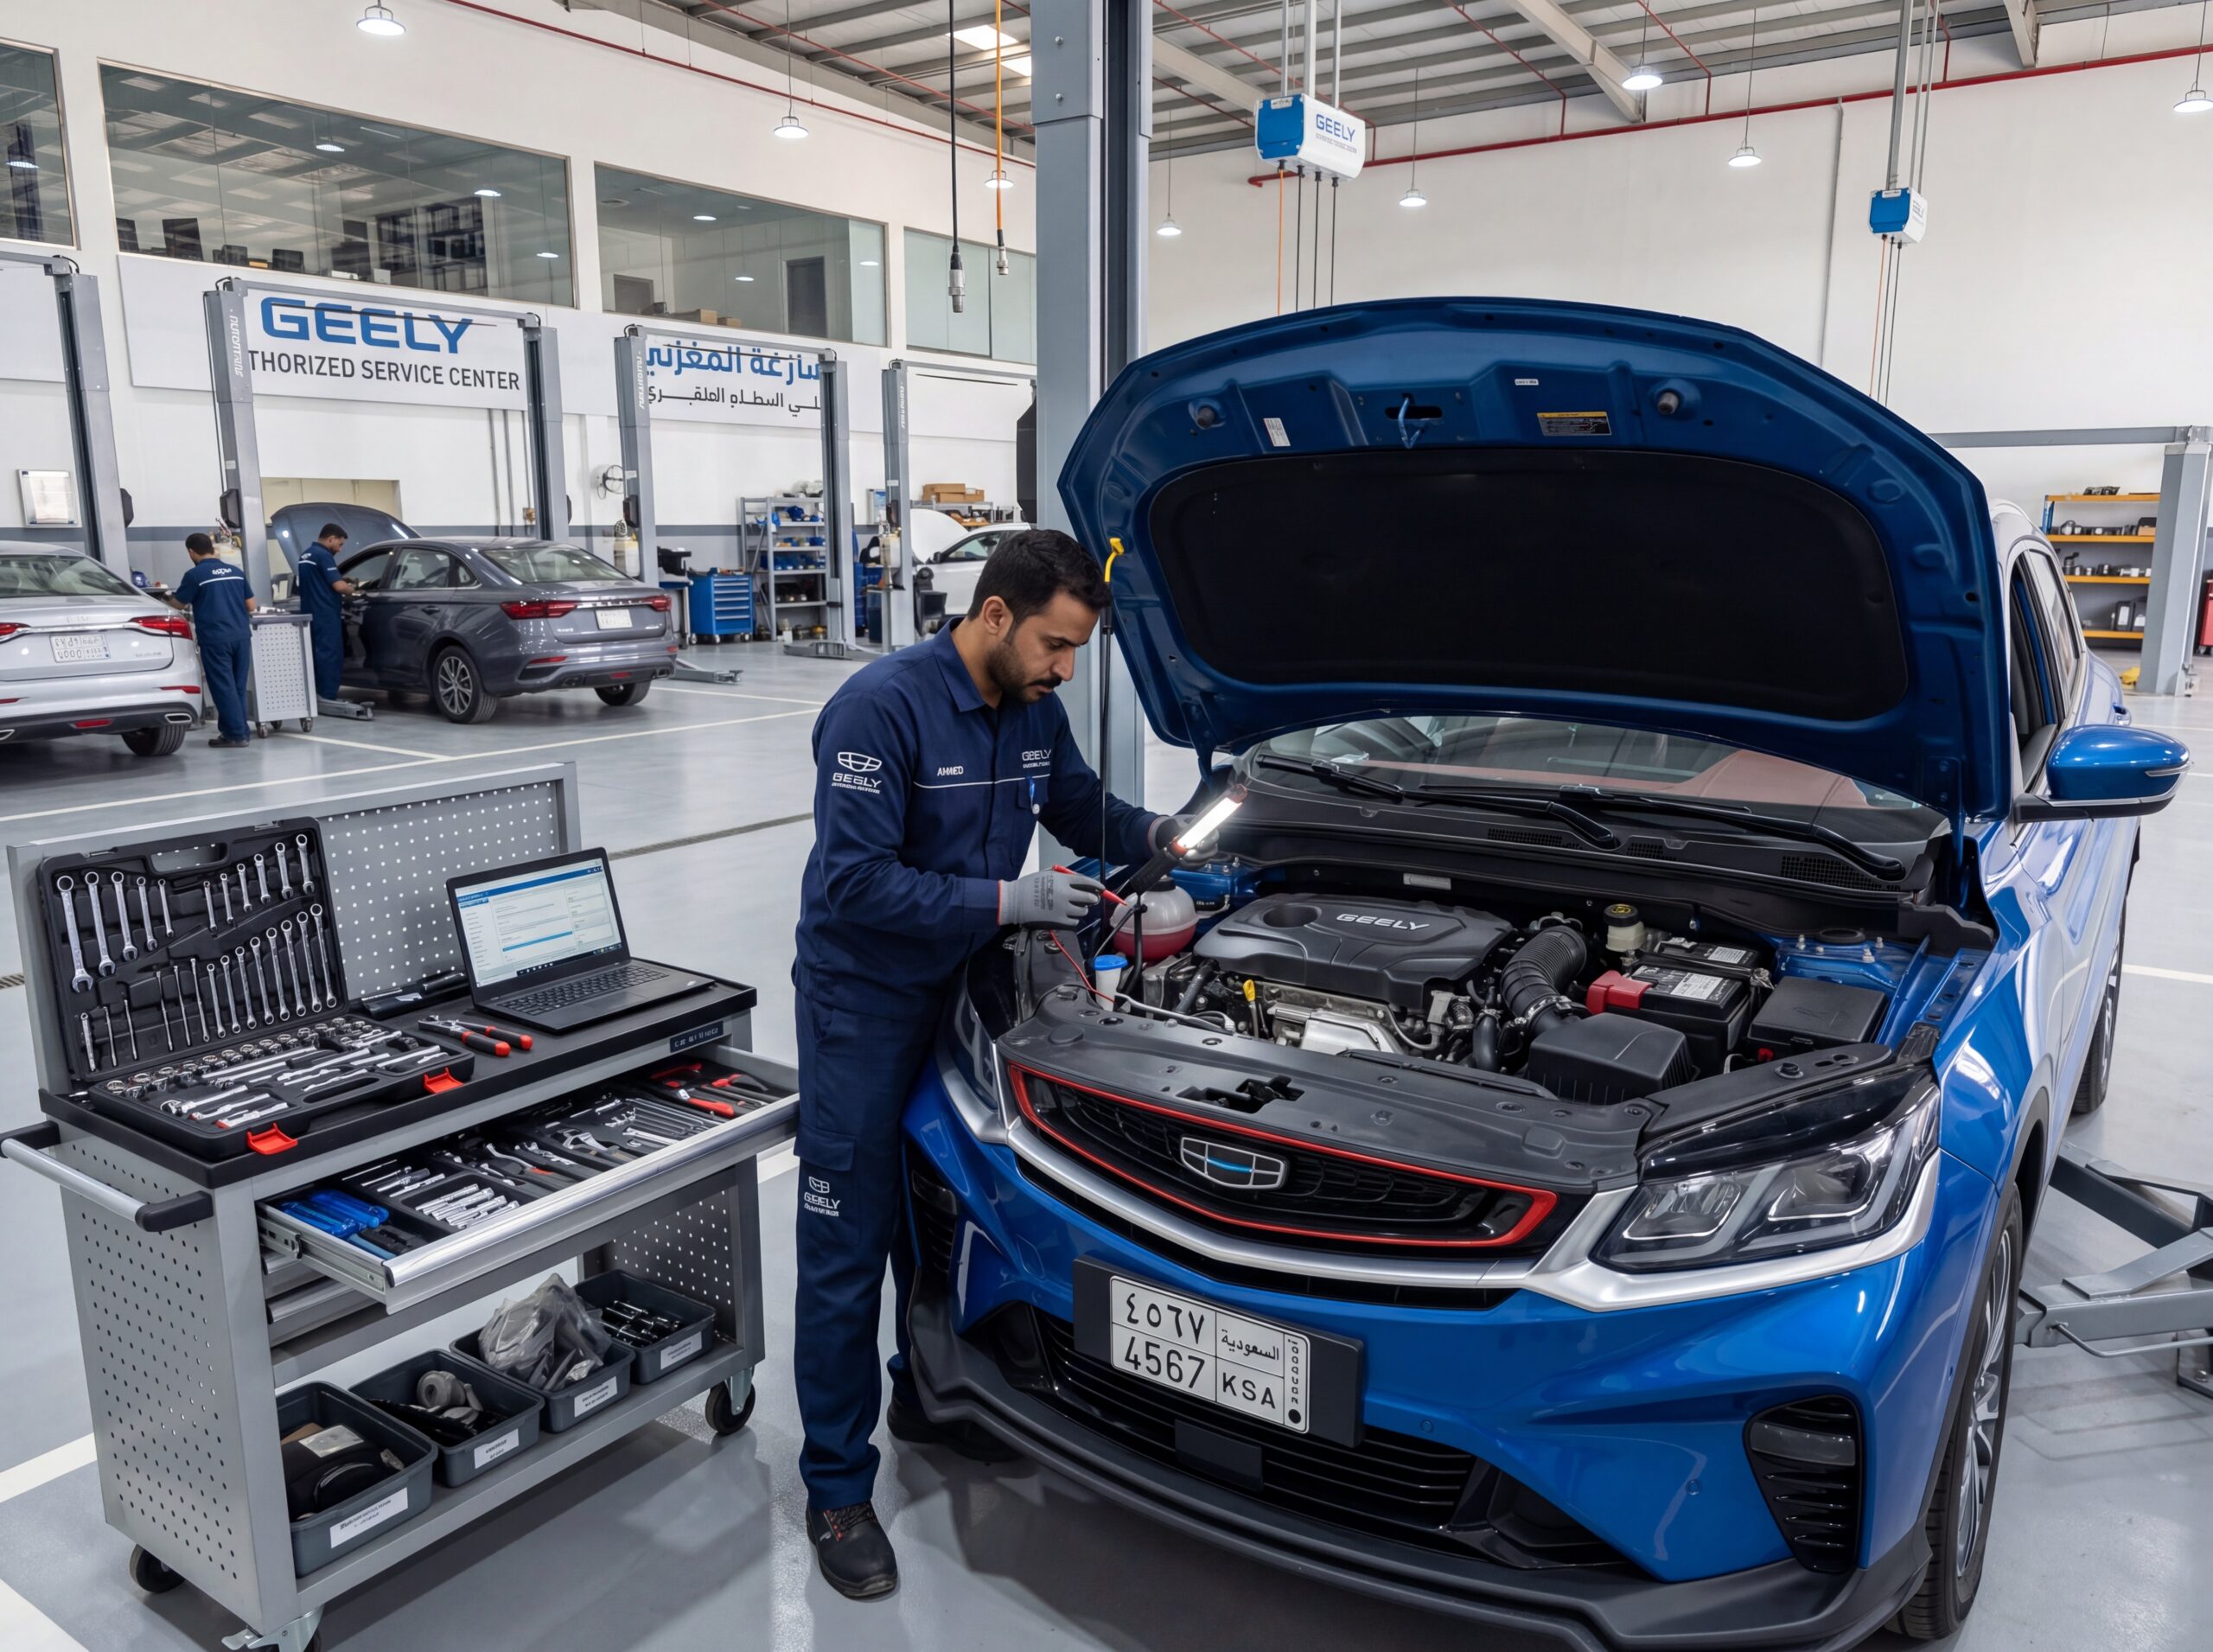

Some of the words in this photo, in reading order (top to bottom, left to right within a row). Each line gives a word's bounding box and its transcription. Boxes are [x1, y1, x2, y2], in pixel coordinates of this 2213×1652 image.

[1316, 113, 1355, 143] GEELY
[260, 297, 474, 354] GEELY
[247, 350, 356, 379] THORIZED
[361, 360, 444, 385] SERVICE
[450, 367, 520, 391] CENTER
[1022, 749, 1052, 761] GEELY
[832, 772, 883, 788] GEELY
[937, 766, 964, 776] AHMED
[1336, 913, 1430, 930] GEELY
[804, 1192, 840, 1209] GEELY
[1126, 1292, 1205, 1344] ٤٥٦٧
[1221, 1329, 1279, 1361] السعودية
[1124, 1336, 1206, 1389] 4567
[1222, 1372, 1276, 1409] KSA
